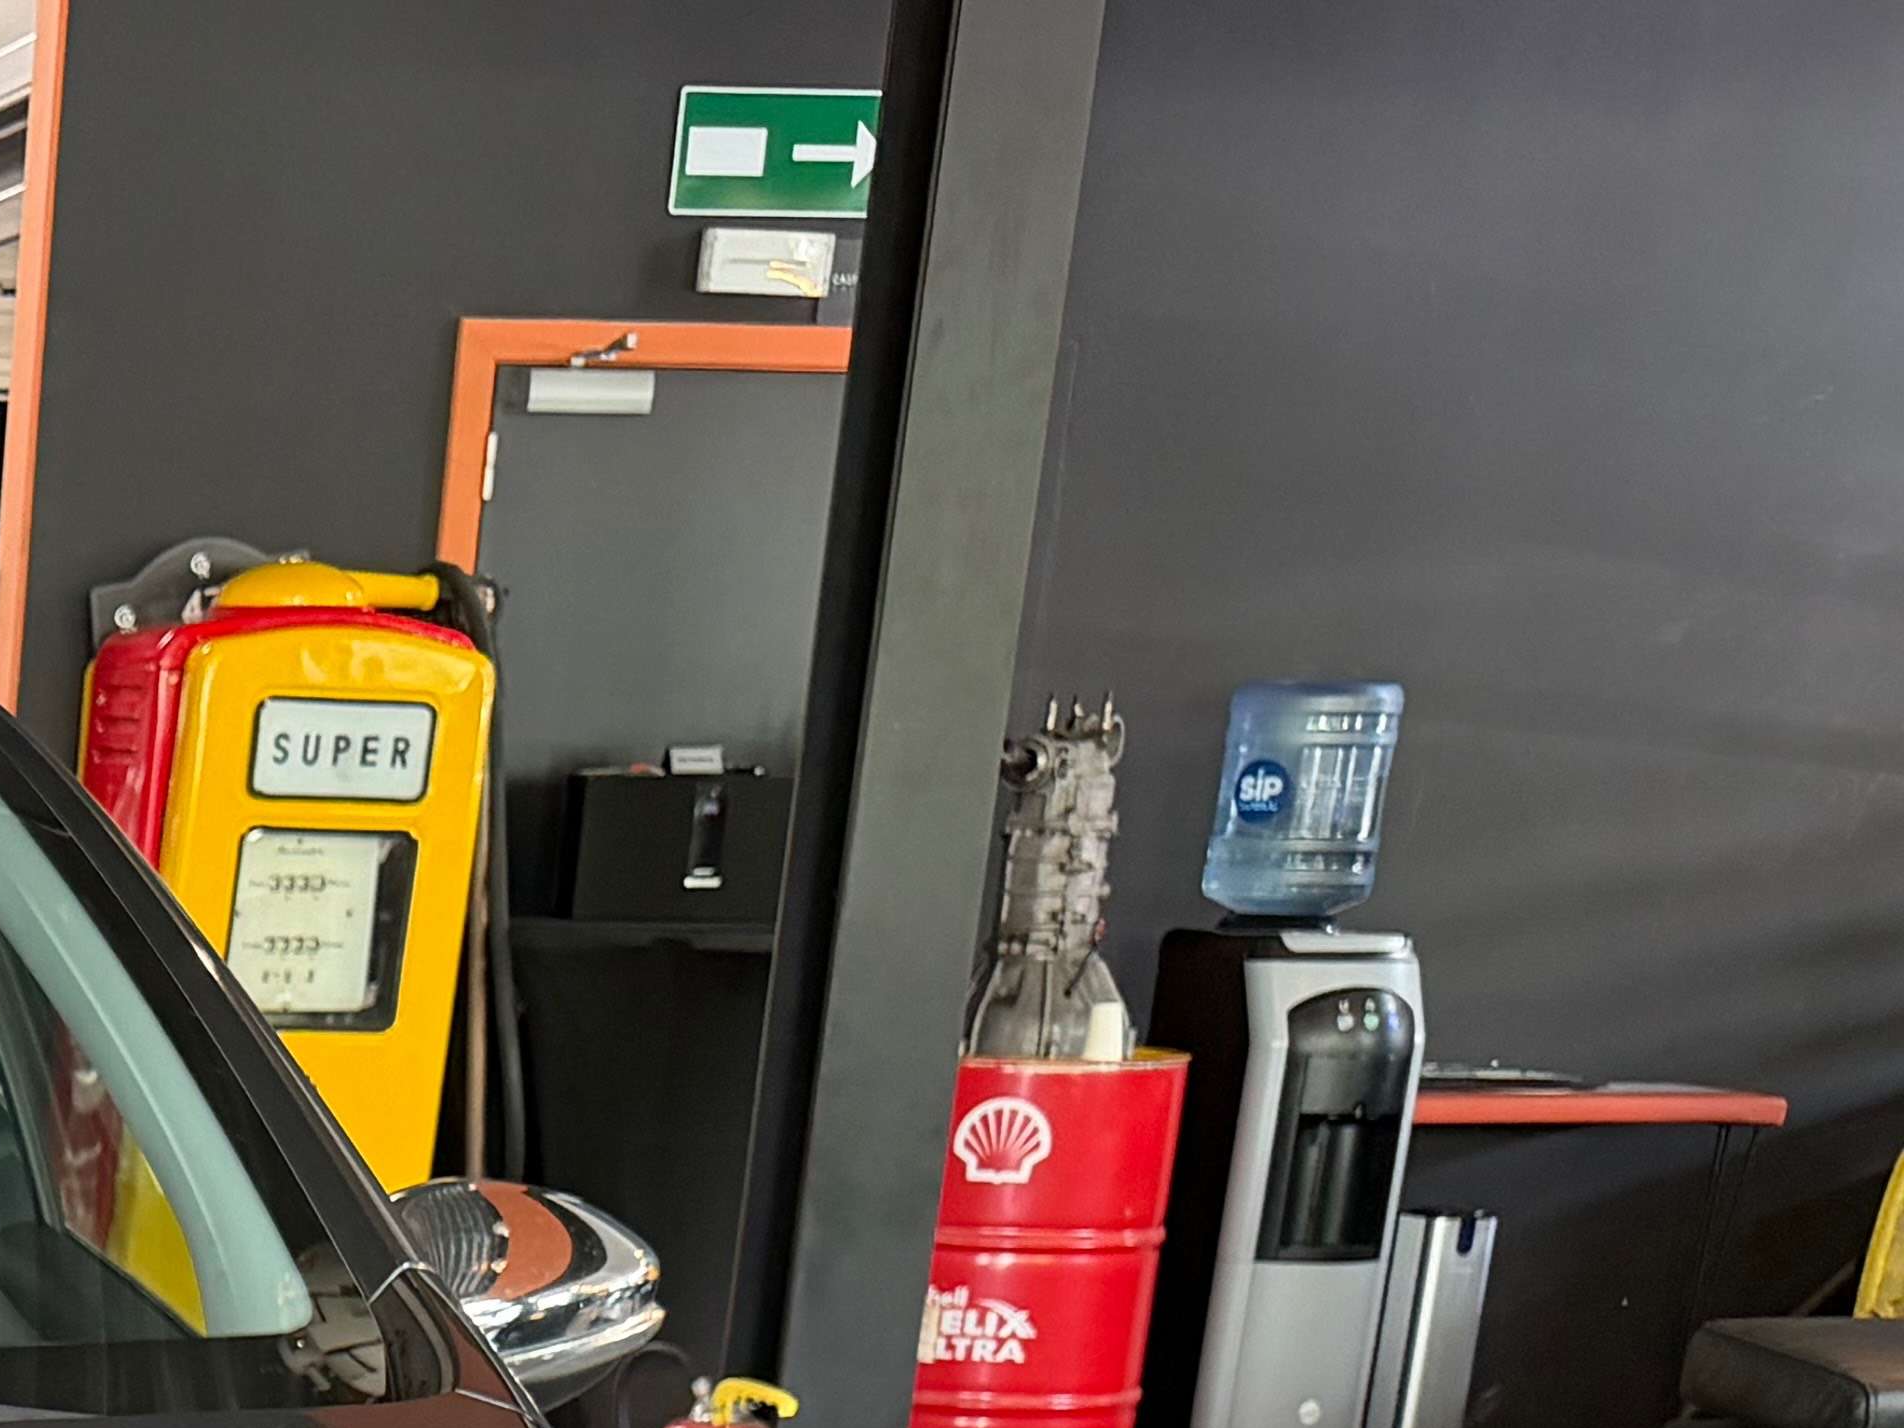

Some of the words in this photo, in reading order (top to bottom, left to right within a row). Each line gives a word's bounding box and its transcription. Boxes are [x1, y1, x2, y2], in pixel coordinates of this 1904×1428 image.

[273, 732, 410, 768] SUPER
[927, 1284, 969, 1309] hell
[940, 1298, 1038, 1339] ELIX
[936, 1336, 1025, 1363] LTRA
